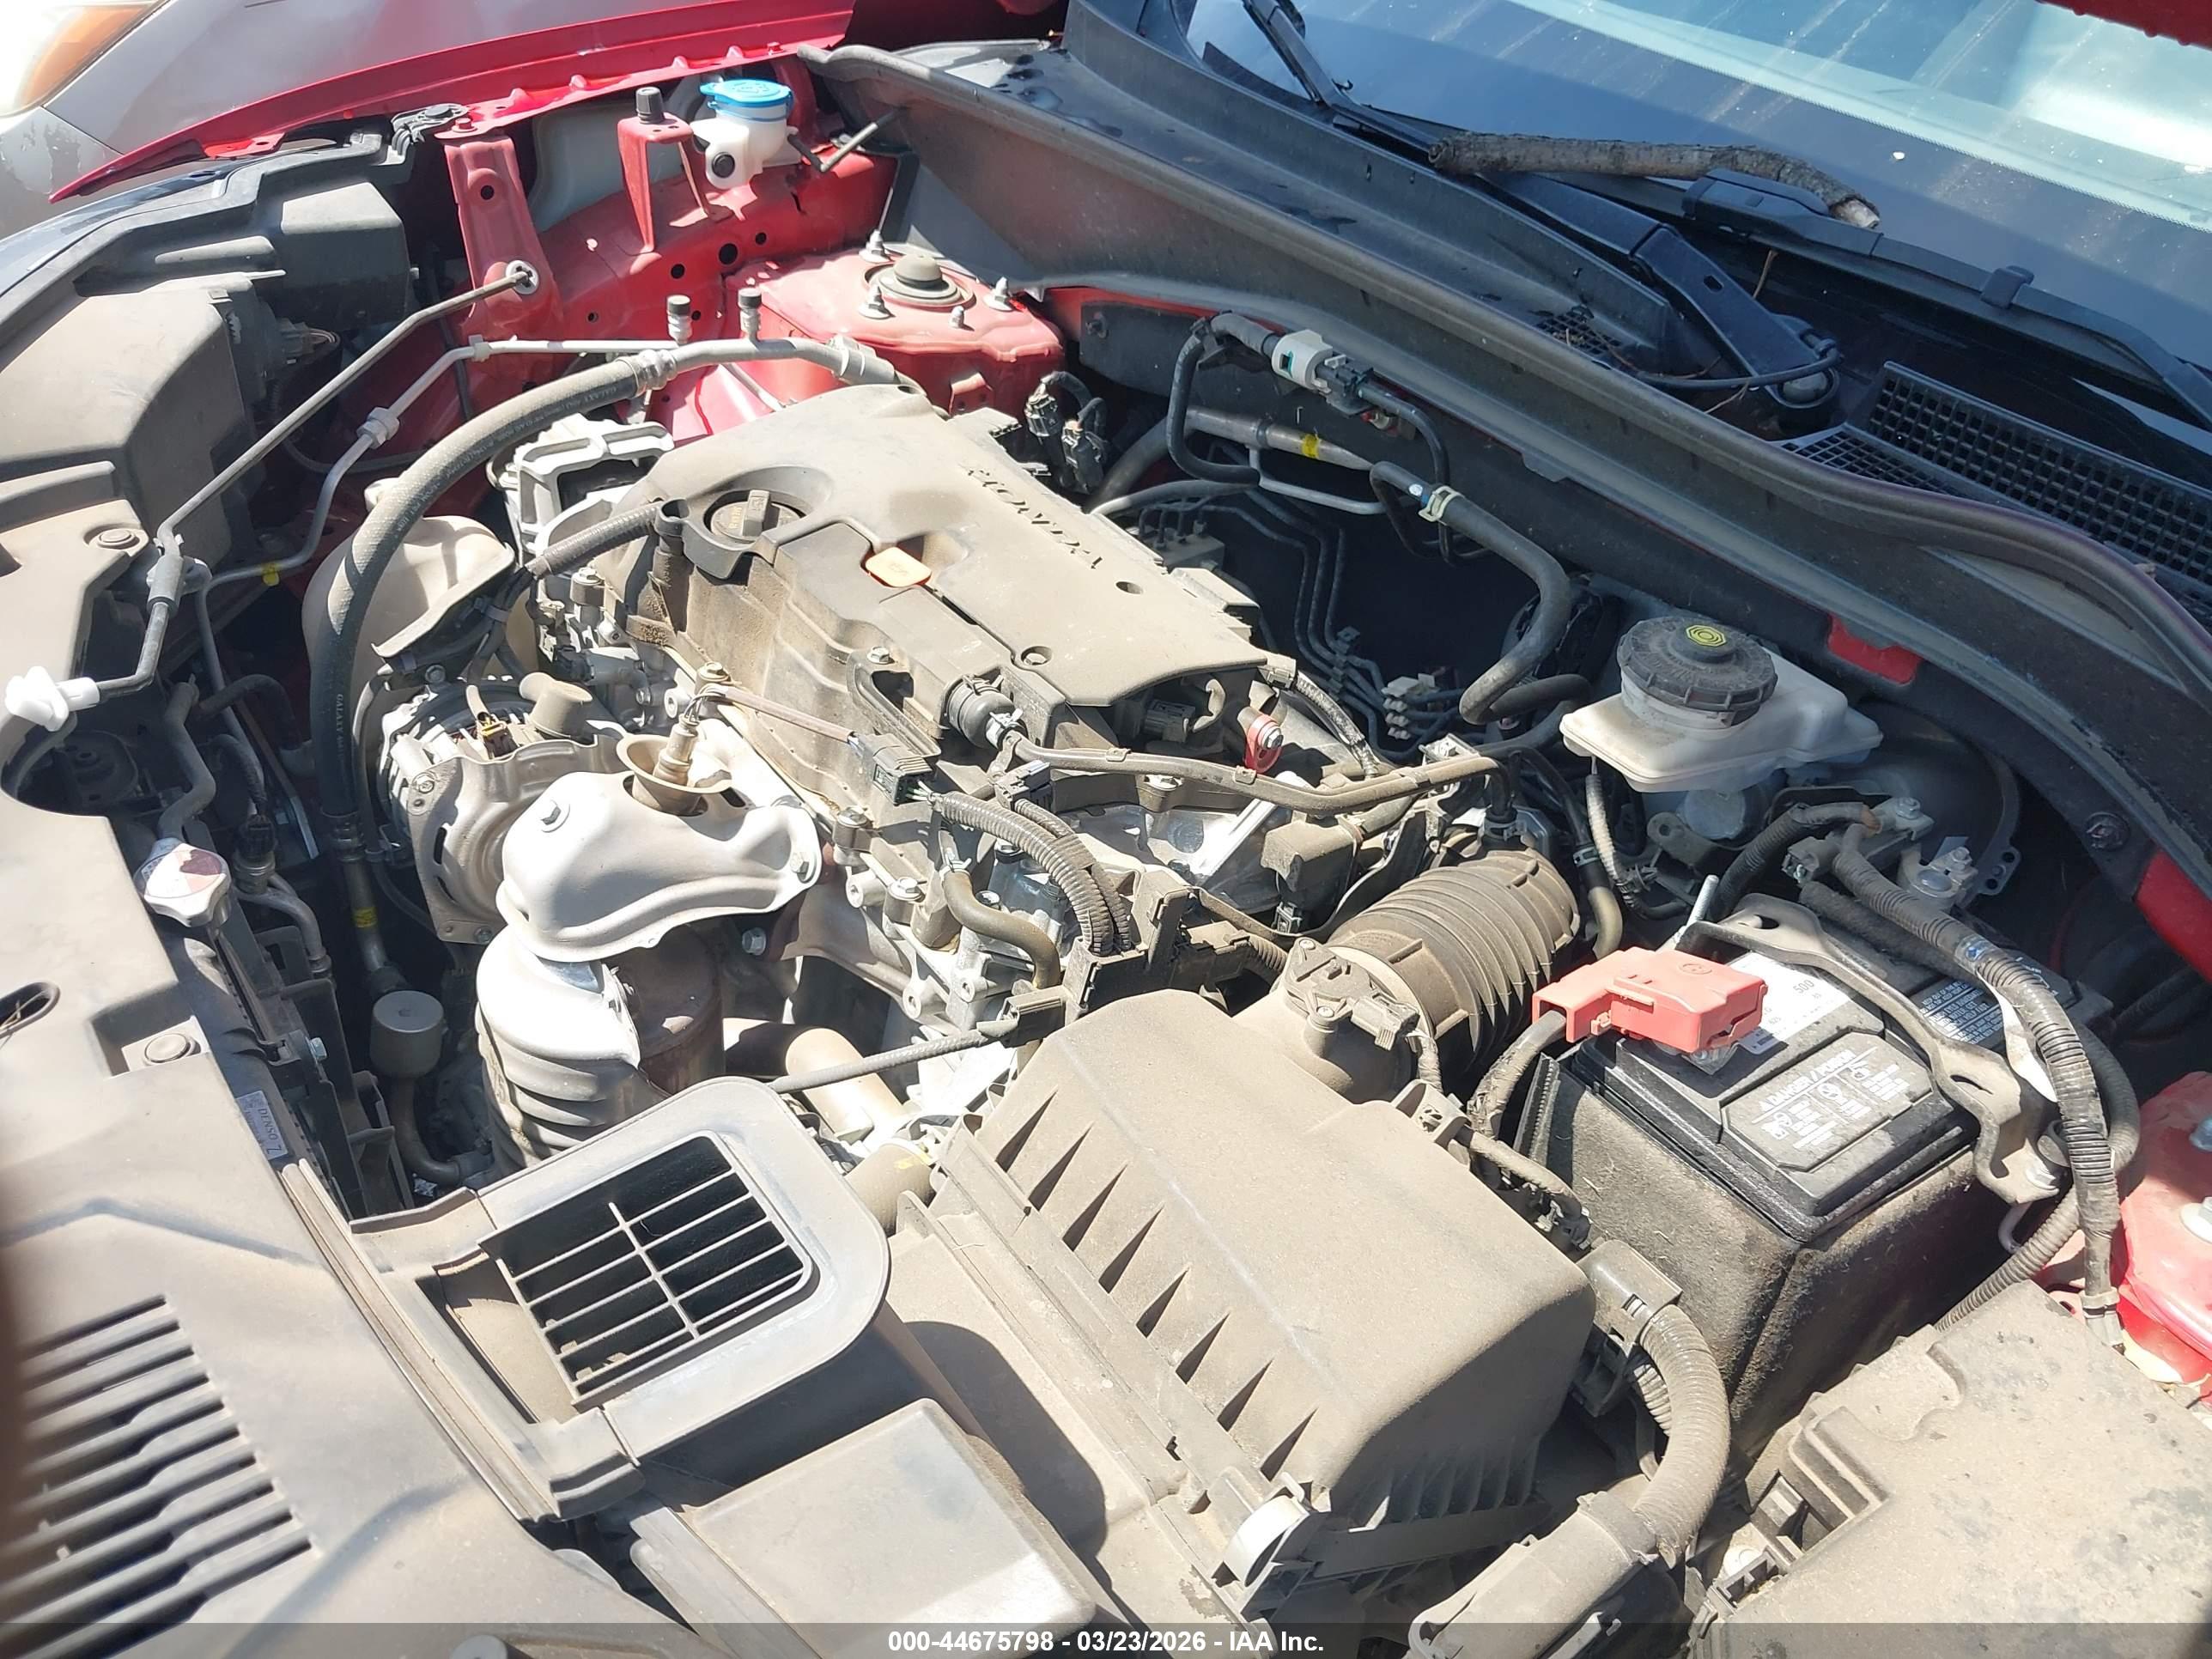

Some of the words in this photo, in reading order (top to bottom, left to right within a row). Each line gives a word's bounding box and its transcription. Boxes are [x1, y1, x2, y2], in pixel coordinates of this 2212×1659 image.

[336, 693, 344, 732] GALAXY
[1793, 979, 1814, 994] 500
[1770, 1075, 1813, 1107] DANGER
[258, 1108, 279, 1140] DENSO
